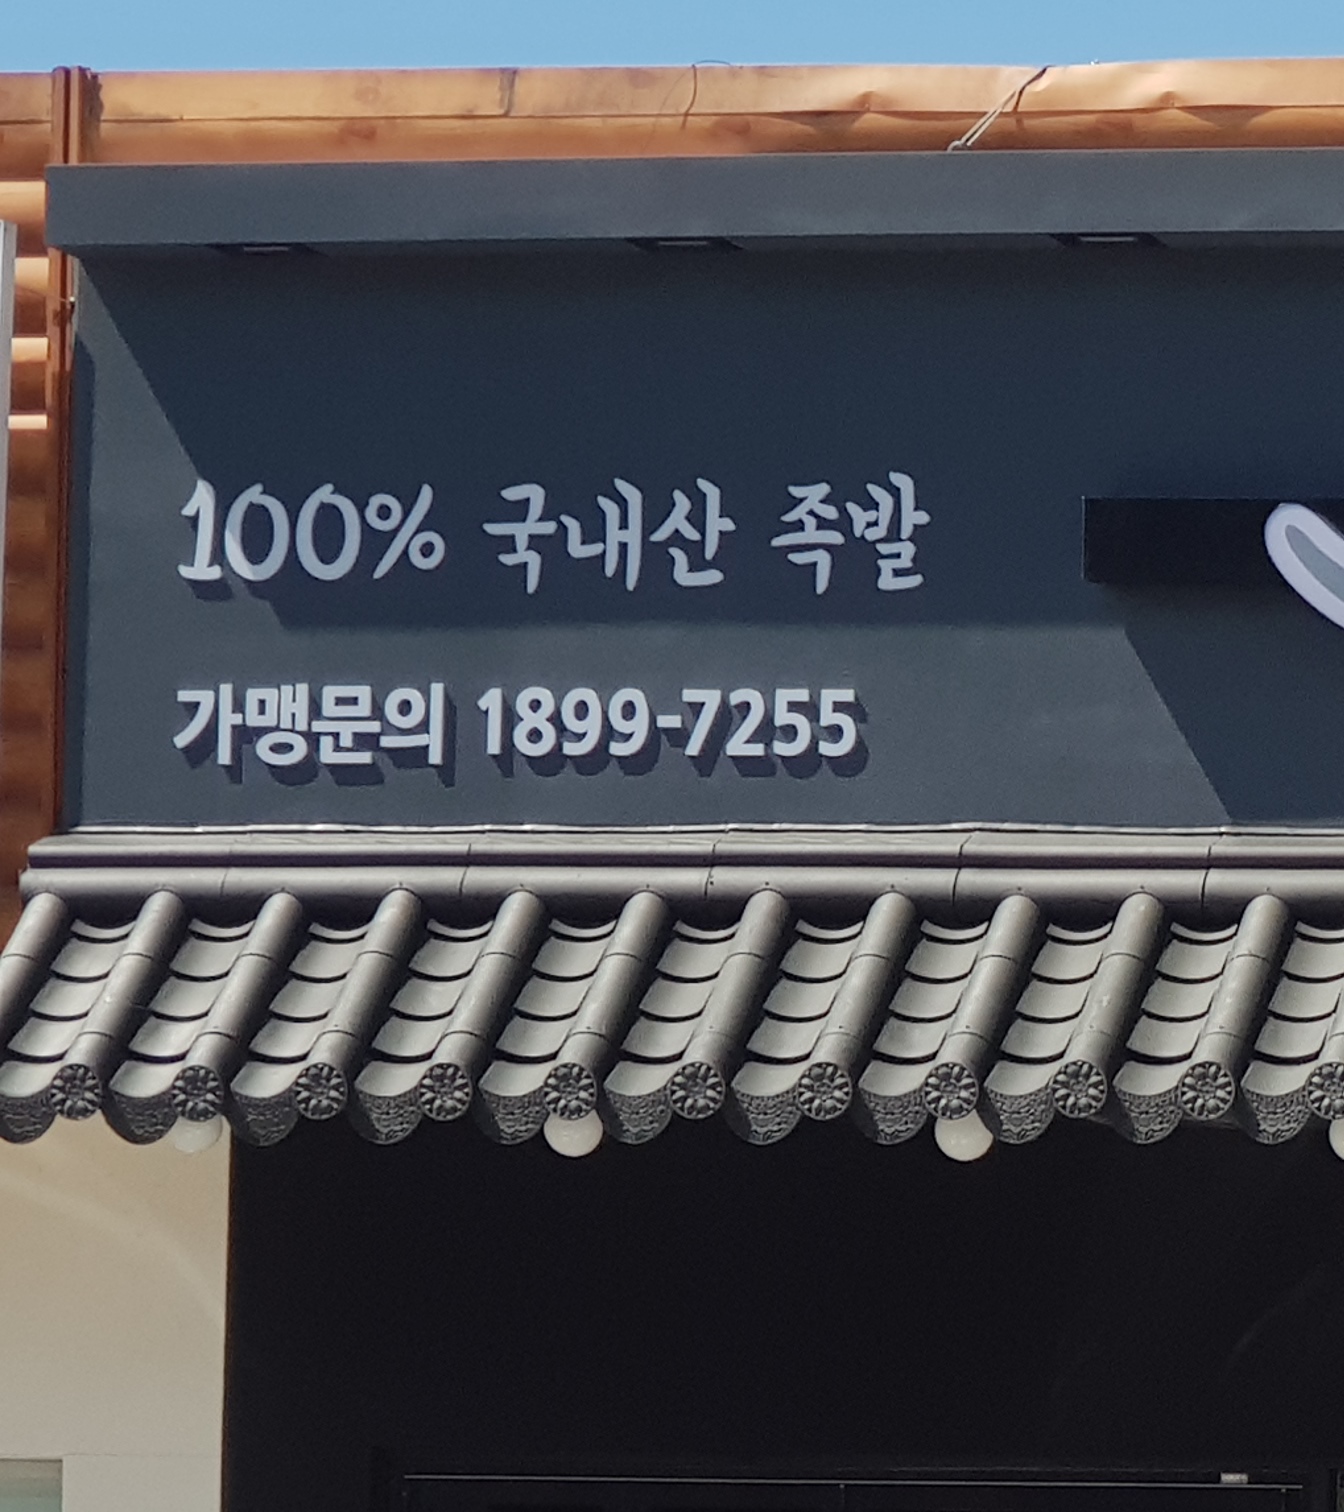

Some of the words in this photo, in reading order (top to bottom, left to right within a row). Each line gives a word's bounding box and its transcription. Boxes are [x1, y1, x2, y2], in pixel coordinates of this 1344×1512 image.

[178, 478, 445, 581] 100%
[482, 478, 736, 593] 국내산
[771, 471, 930, 593] 족발
[173, 683, 444, 766] 가맹문의
[477, 688, 857, 756] 1899-7255
